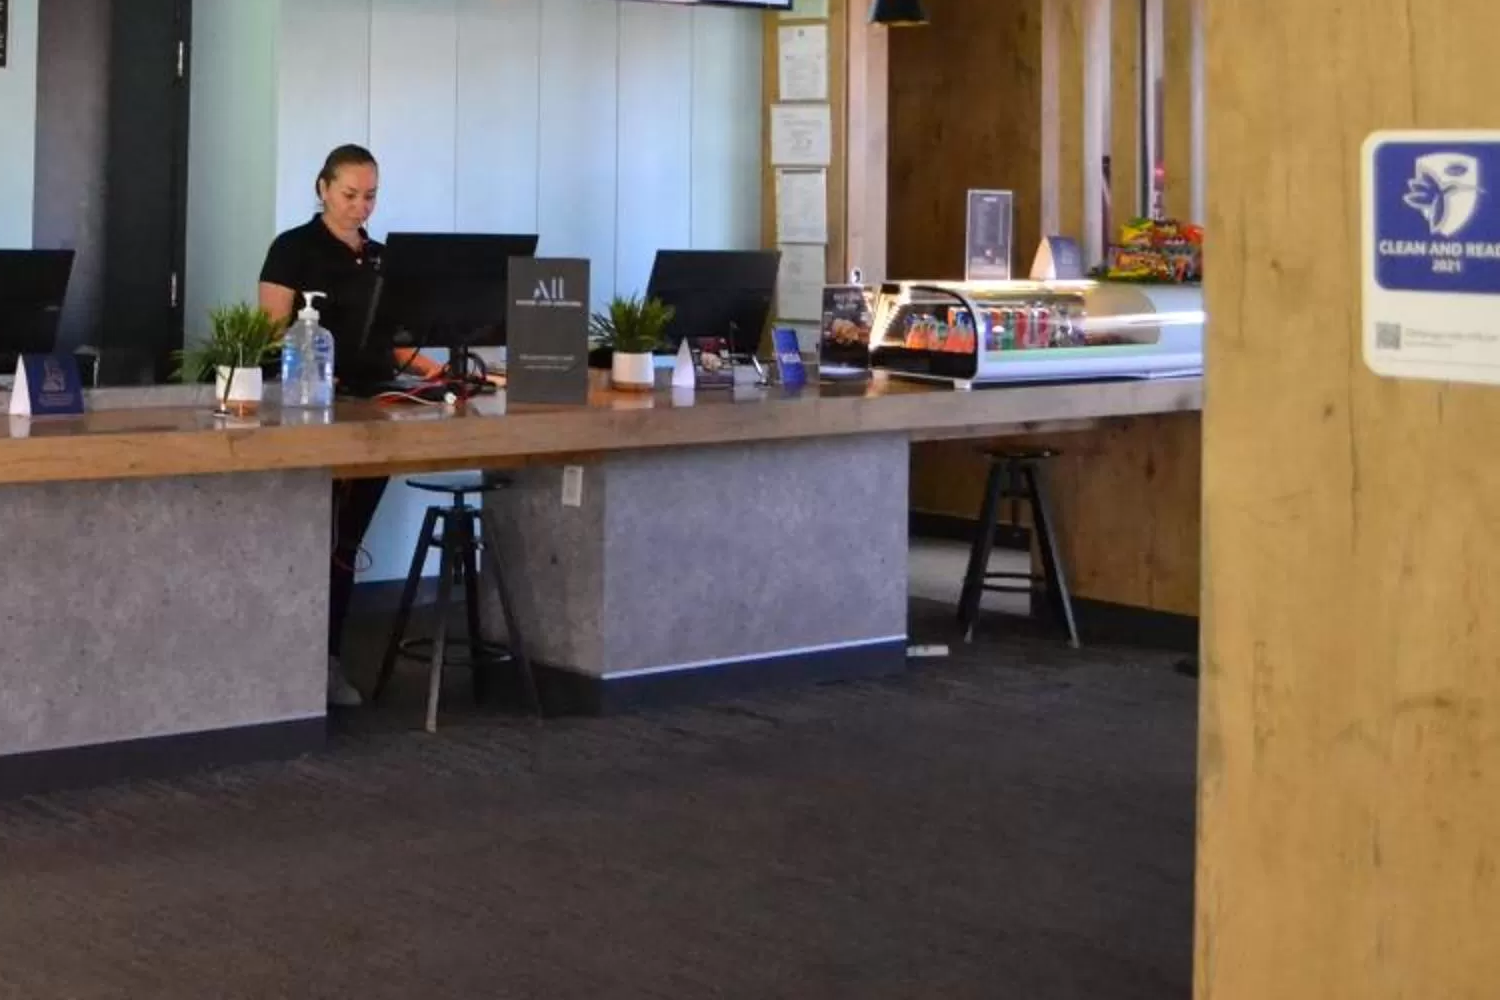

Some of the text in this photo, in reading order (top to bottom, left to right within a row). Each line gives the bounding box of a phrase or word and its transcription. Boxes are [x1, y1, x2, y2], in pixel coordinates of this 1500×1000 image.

[1379, 240, 1426, 255] CLEAN
[1430, 241, 1462, 256] AND
[1432, 260, 1461, 272] 2021
